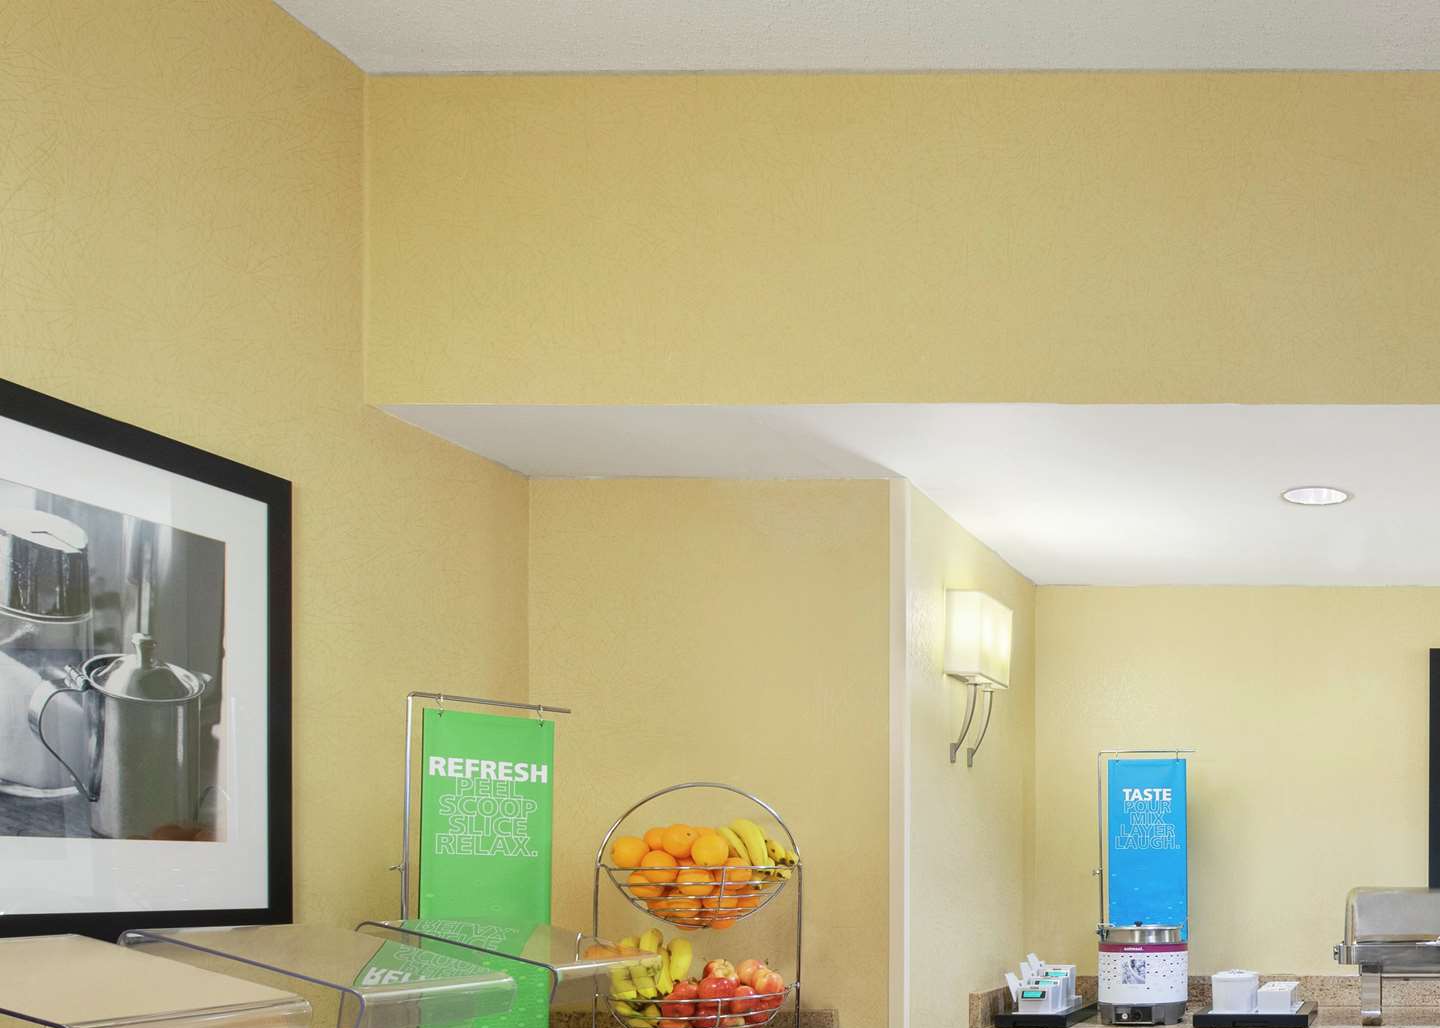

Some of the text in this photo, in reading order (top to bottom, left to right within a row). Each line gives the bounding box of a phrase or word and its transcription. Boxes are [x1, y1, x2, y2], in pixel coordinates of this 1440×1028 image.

[428, 756, 548, 784] REFRESH
[455, 776, 524, 800] PEEL
[1122, 788, 1172, 801] TASTE
[438, 794, 538, 819] SCOOP
[1123, 800, 1172, 813] POUR
[448, 814, 528, 838] SLICE
[1130, 812, 1165, 825] MIX
[1120, 824, 1176, 837] LAYER
[435, 832, 538, 857] RELAX.
[1115, 836, 1180, 850] LAUGH.
